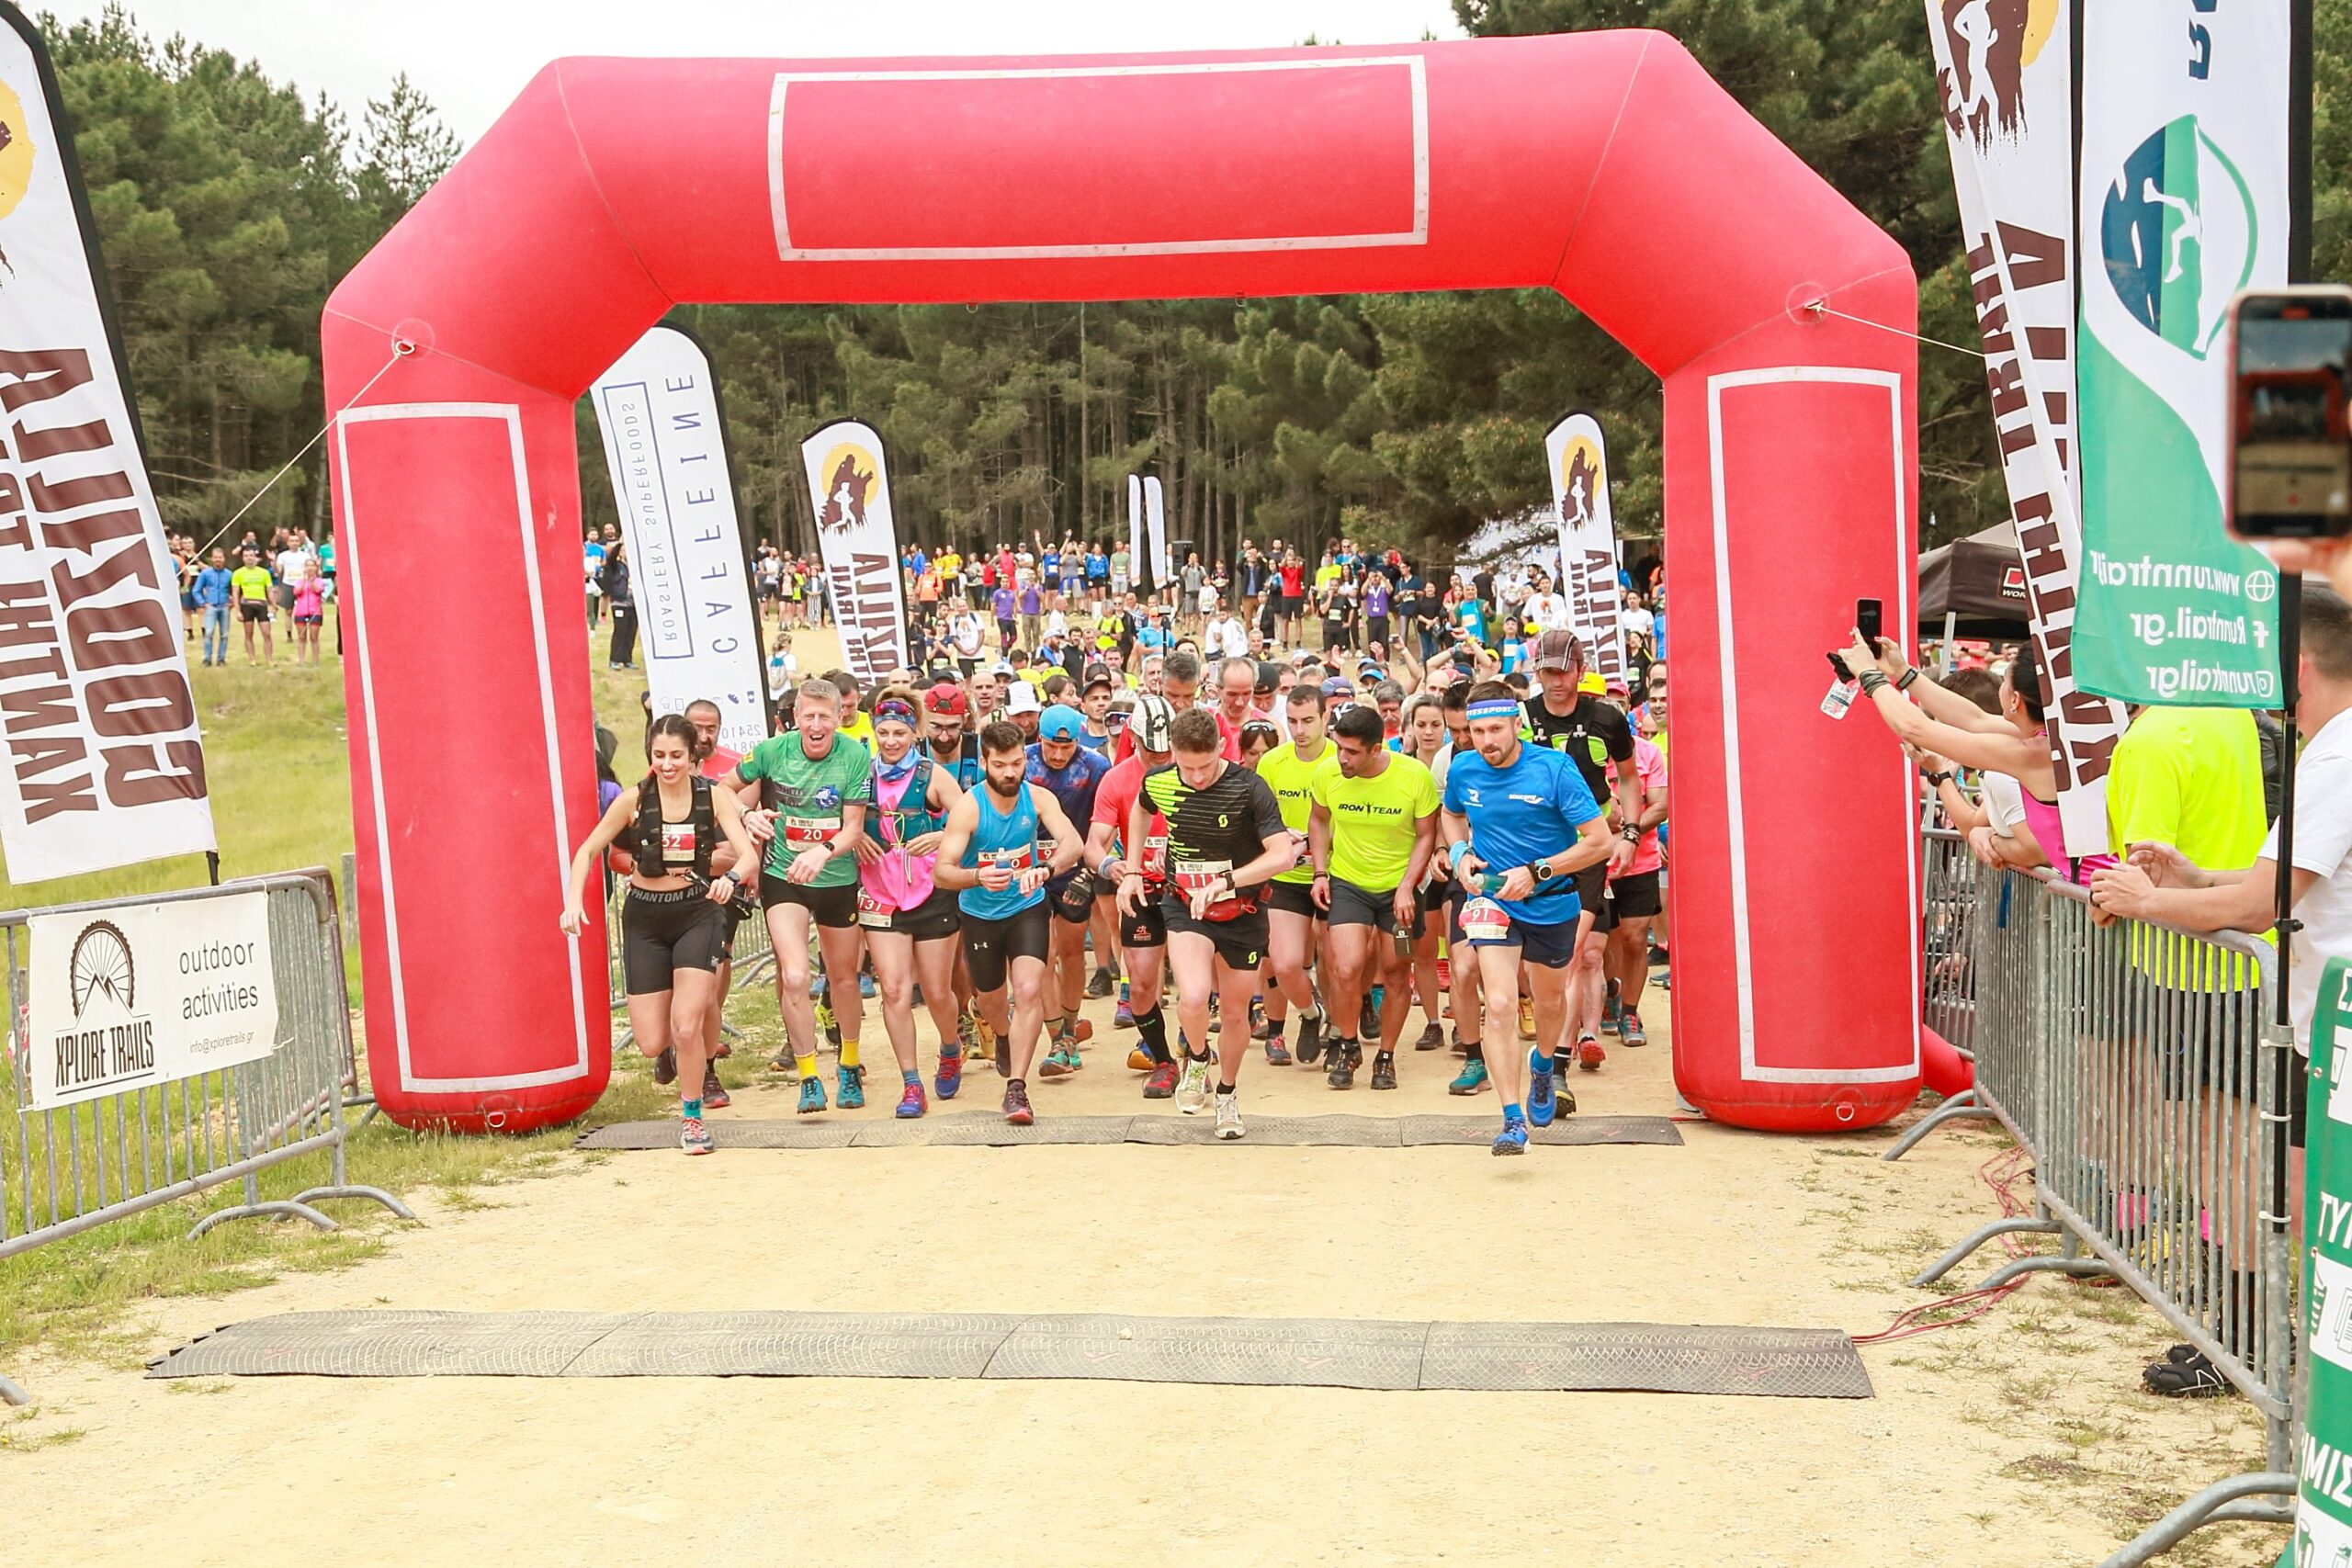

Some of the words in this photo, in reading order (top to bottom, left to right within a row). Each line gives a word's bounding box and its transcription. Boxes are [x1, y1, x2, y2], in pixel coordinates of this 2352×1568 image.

[1278, 789, 1301, 798] IRON
[1338, 803, 1364, 813] IRON
[1373, 807, 1402, 816] TEAM
[803, 829, 822, 840] 20
[1044, 849, 1052, 860] 9
[1012, 858, 1020, 869] 0
[631, 888, 684, 903] PHANTOM
[1472, 908, 1488, 921] 91
[179, 939, 254, 975] outdoor
[182, 981, 259, 1020] activities
[189, 1030, 254, 1055] info@xploretrails.gr
[55, 1030, 107, 1088] XPLORE
[109, 1020, 155, 1077] TRAILS
[2301, 1431, 2352, 1509] ΜΙΣ
